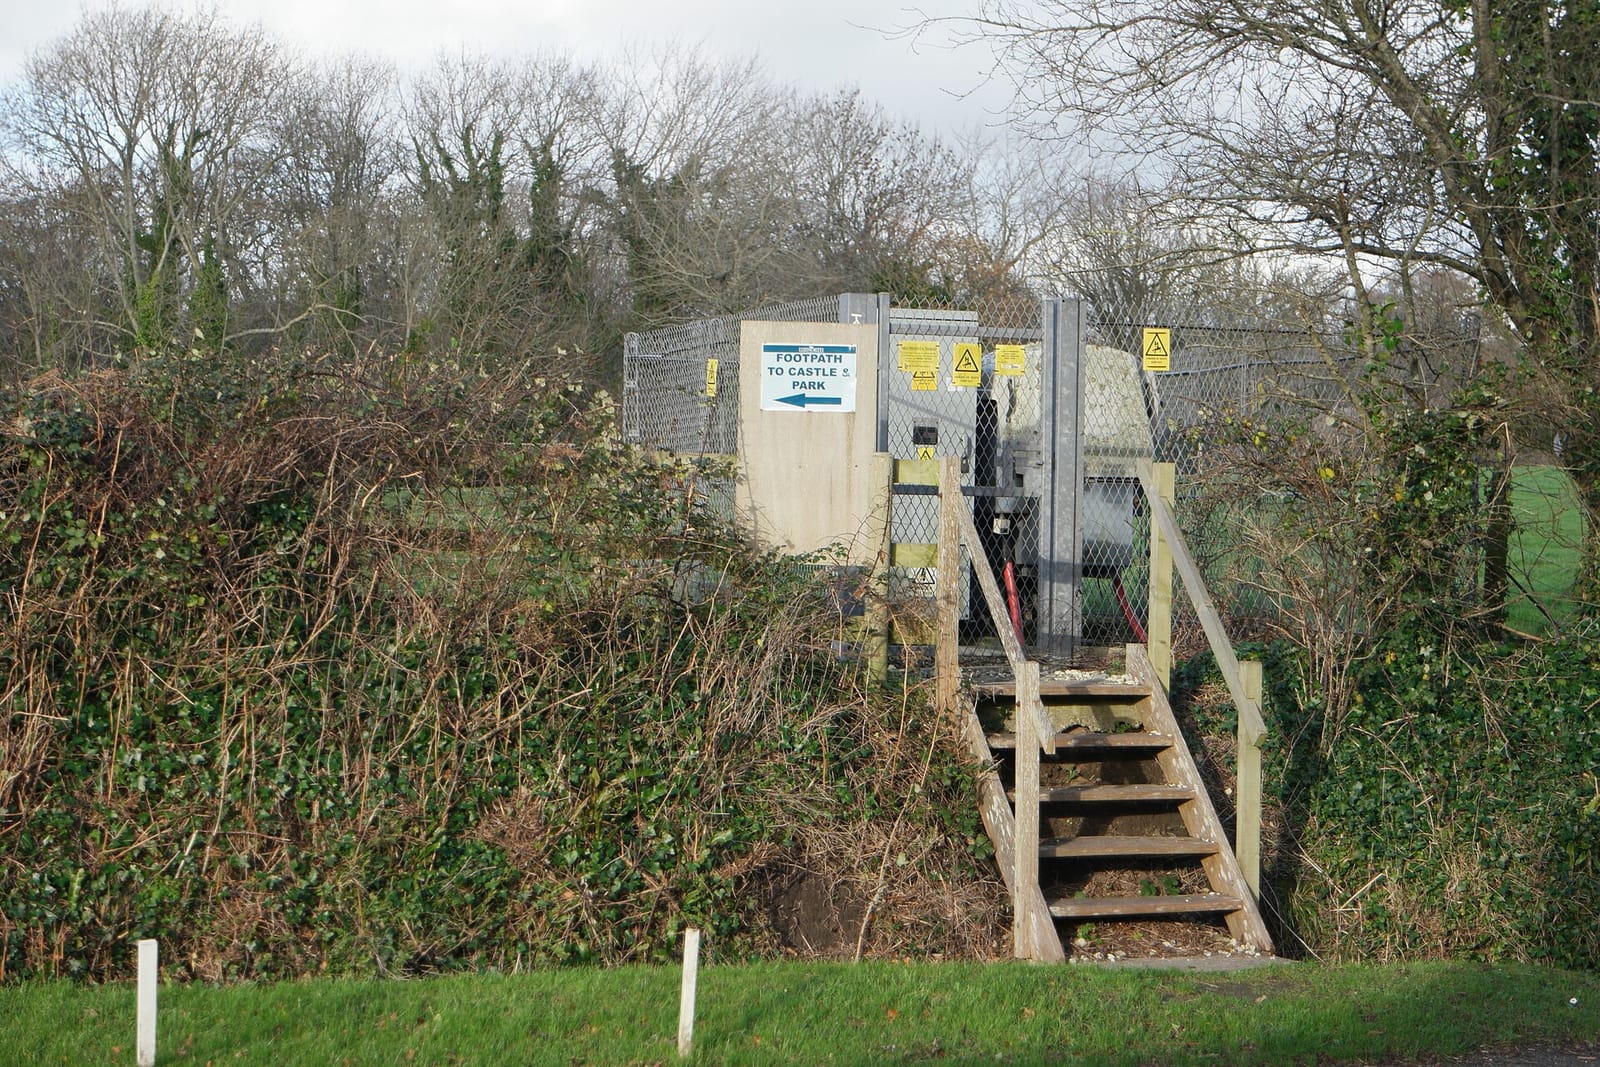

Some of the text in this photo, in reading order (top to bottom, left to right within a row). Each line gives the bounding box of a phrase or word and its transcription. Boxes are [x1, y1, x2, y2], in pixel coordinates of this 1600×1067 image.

[776, 353, 842, 363] FOOTPATH
[767, 366, 850, 377] TO CASTLE &
[792, 380, 826, 390] PARK
